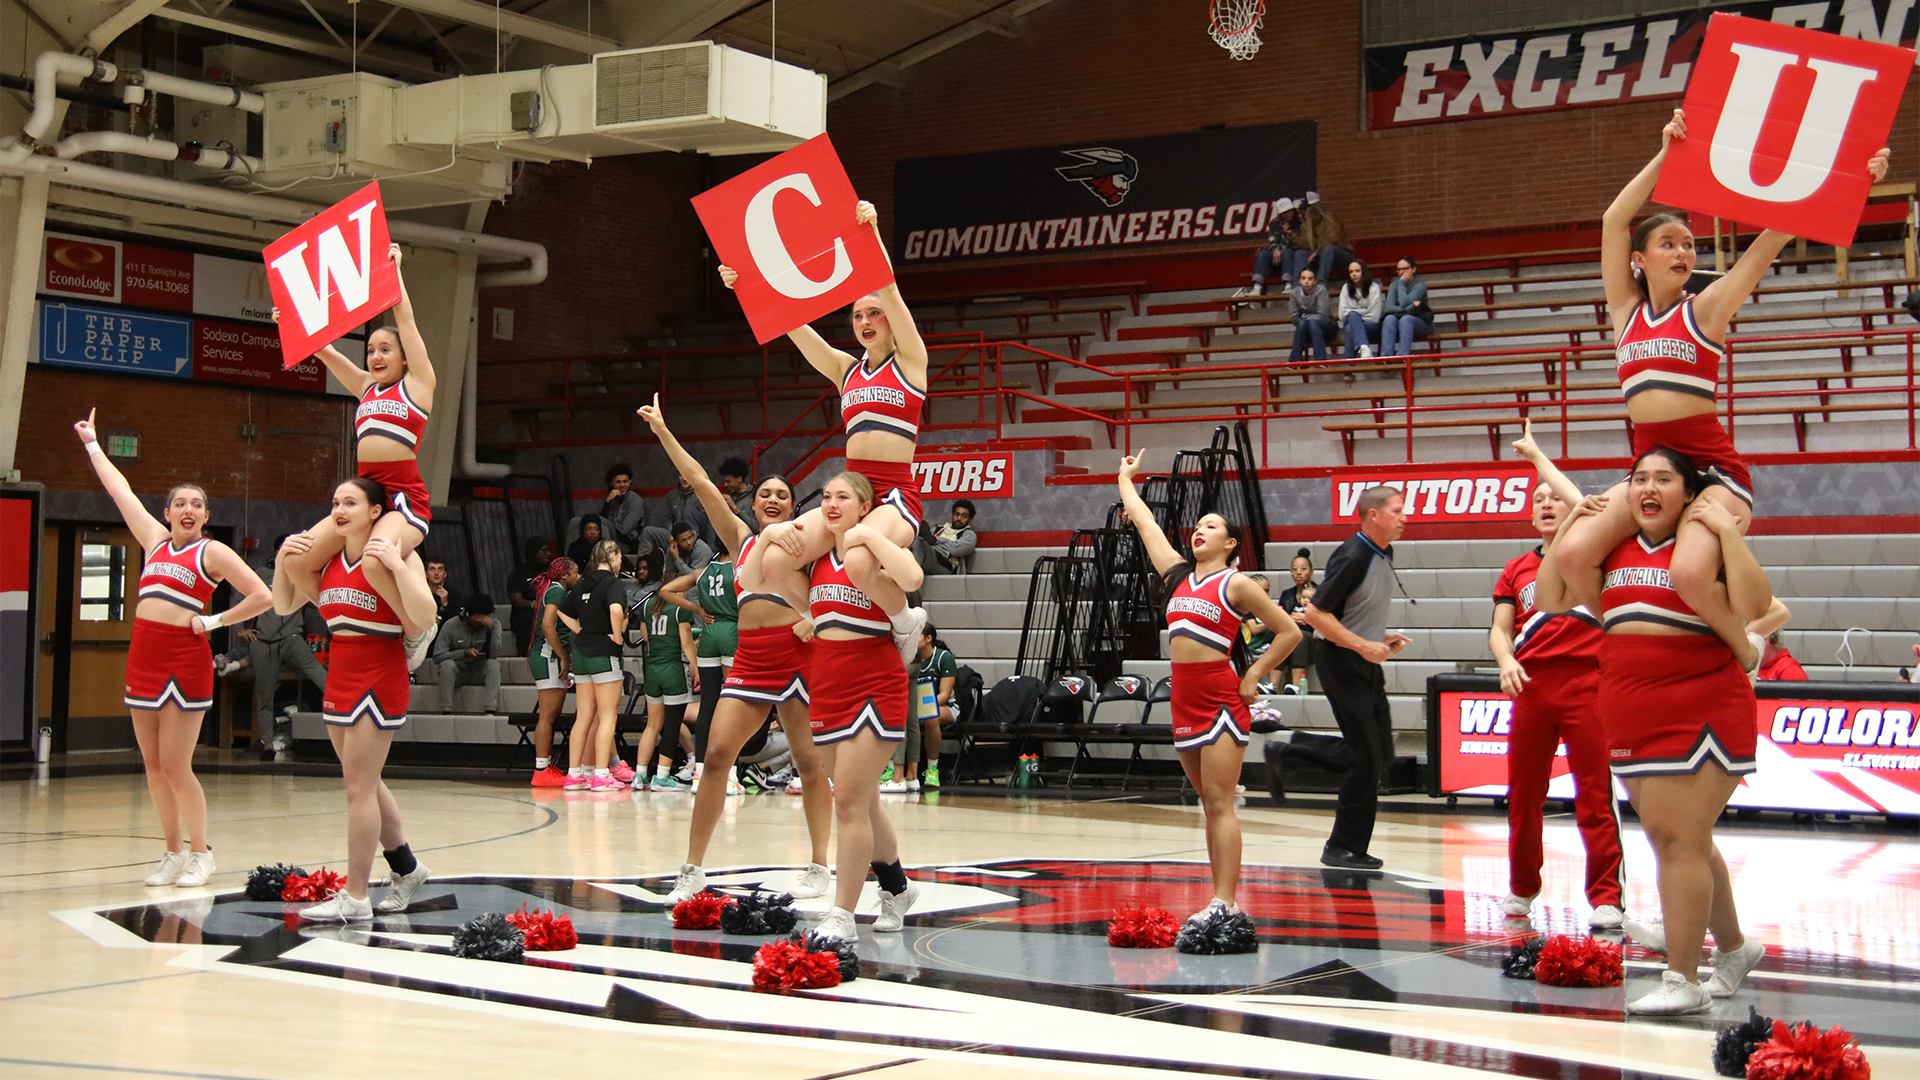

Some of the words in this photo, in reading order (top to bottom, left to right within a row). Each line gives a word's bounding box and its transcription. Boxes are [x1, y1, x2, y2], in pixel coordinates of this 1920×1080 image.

[1709, 42, 1878, 202] U
[745, 173, 854, 299] C
[125, 262, 139, 272] 411
[141, 264, 146, 273] E
[148, 265, 177, 277] Tomichi
[178, 269, 191, 280] Ave
[271, 199, 377, 337] W
[49, 270, 112, 293] EconoLodge
[126, 276, 190, 295] 970.641.3068
[241, 307, 253, 317] i'm
[85, 314, 132, 333] THE
[85, 329, 162, 351] PAPER
[202, 327, 239, 344] Sodexo
[241, 332, 281, 349] Campus
[84, 345, 143, 364] CLIP
[202, 344, 244, 362] Services
[202, 365, 271, 380] www.western.edu/dining
[651, 614, 668, 636] 10
